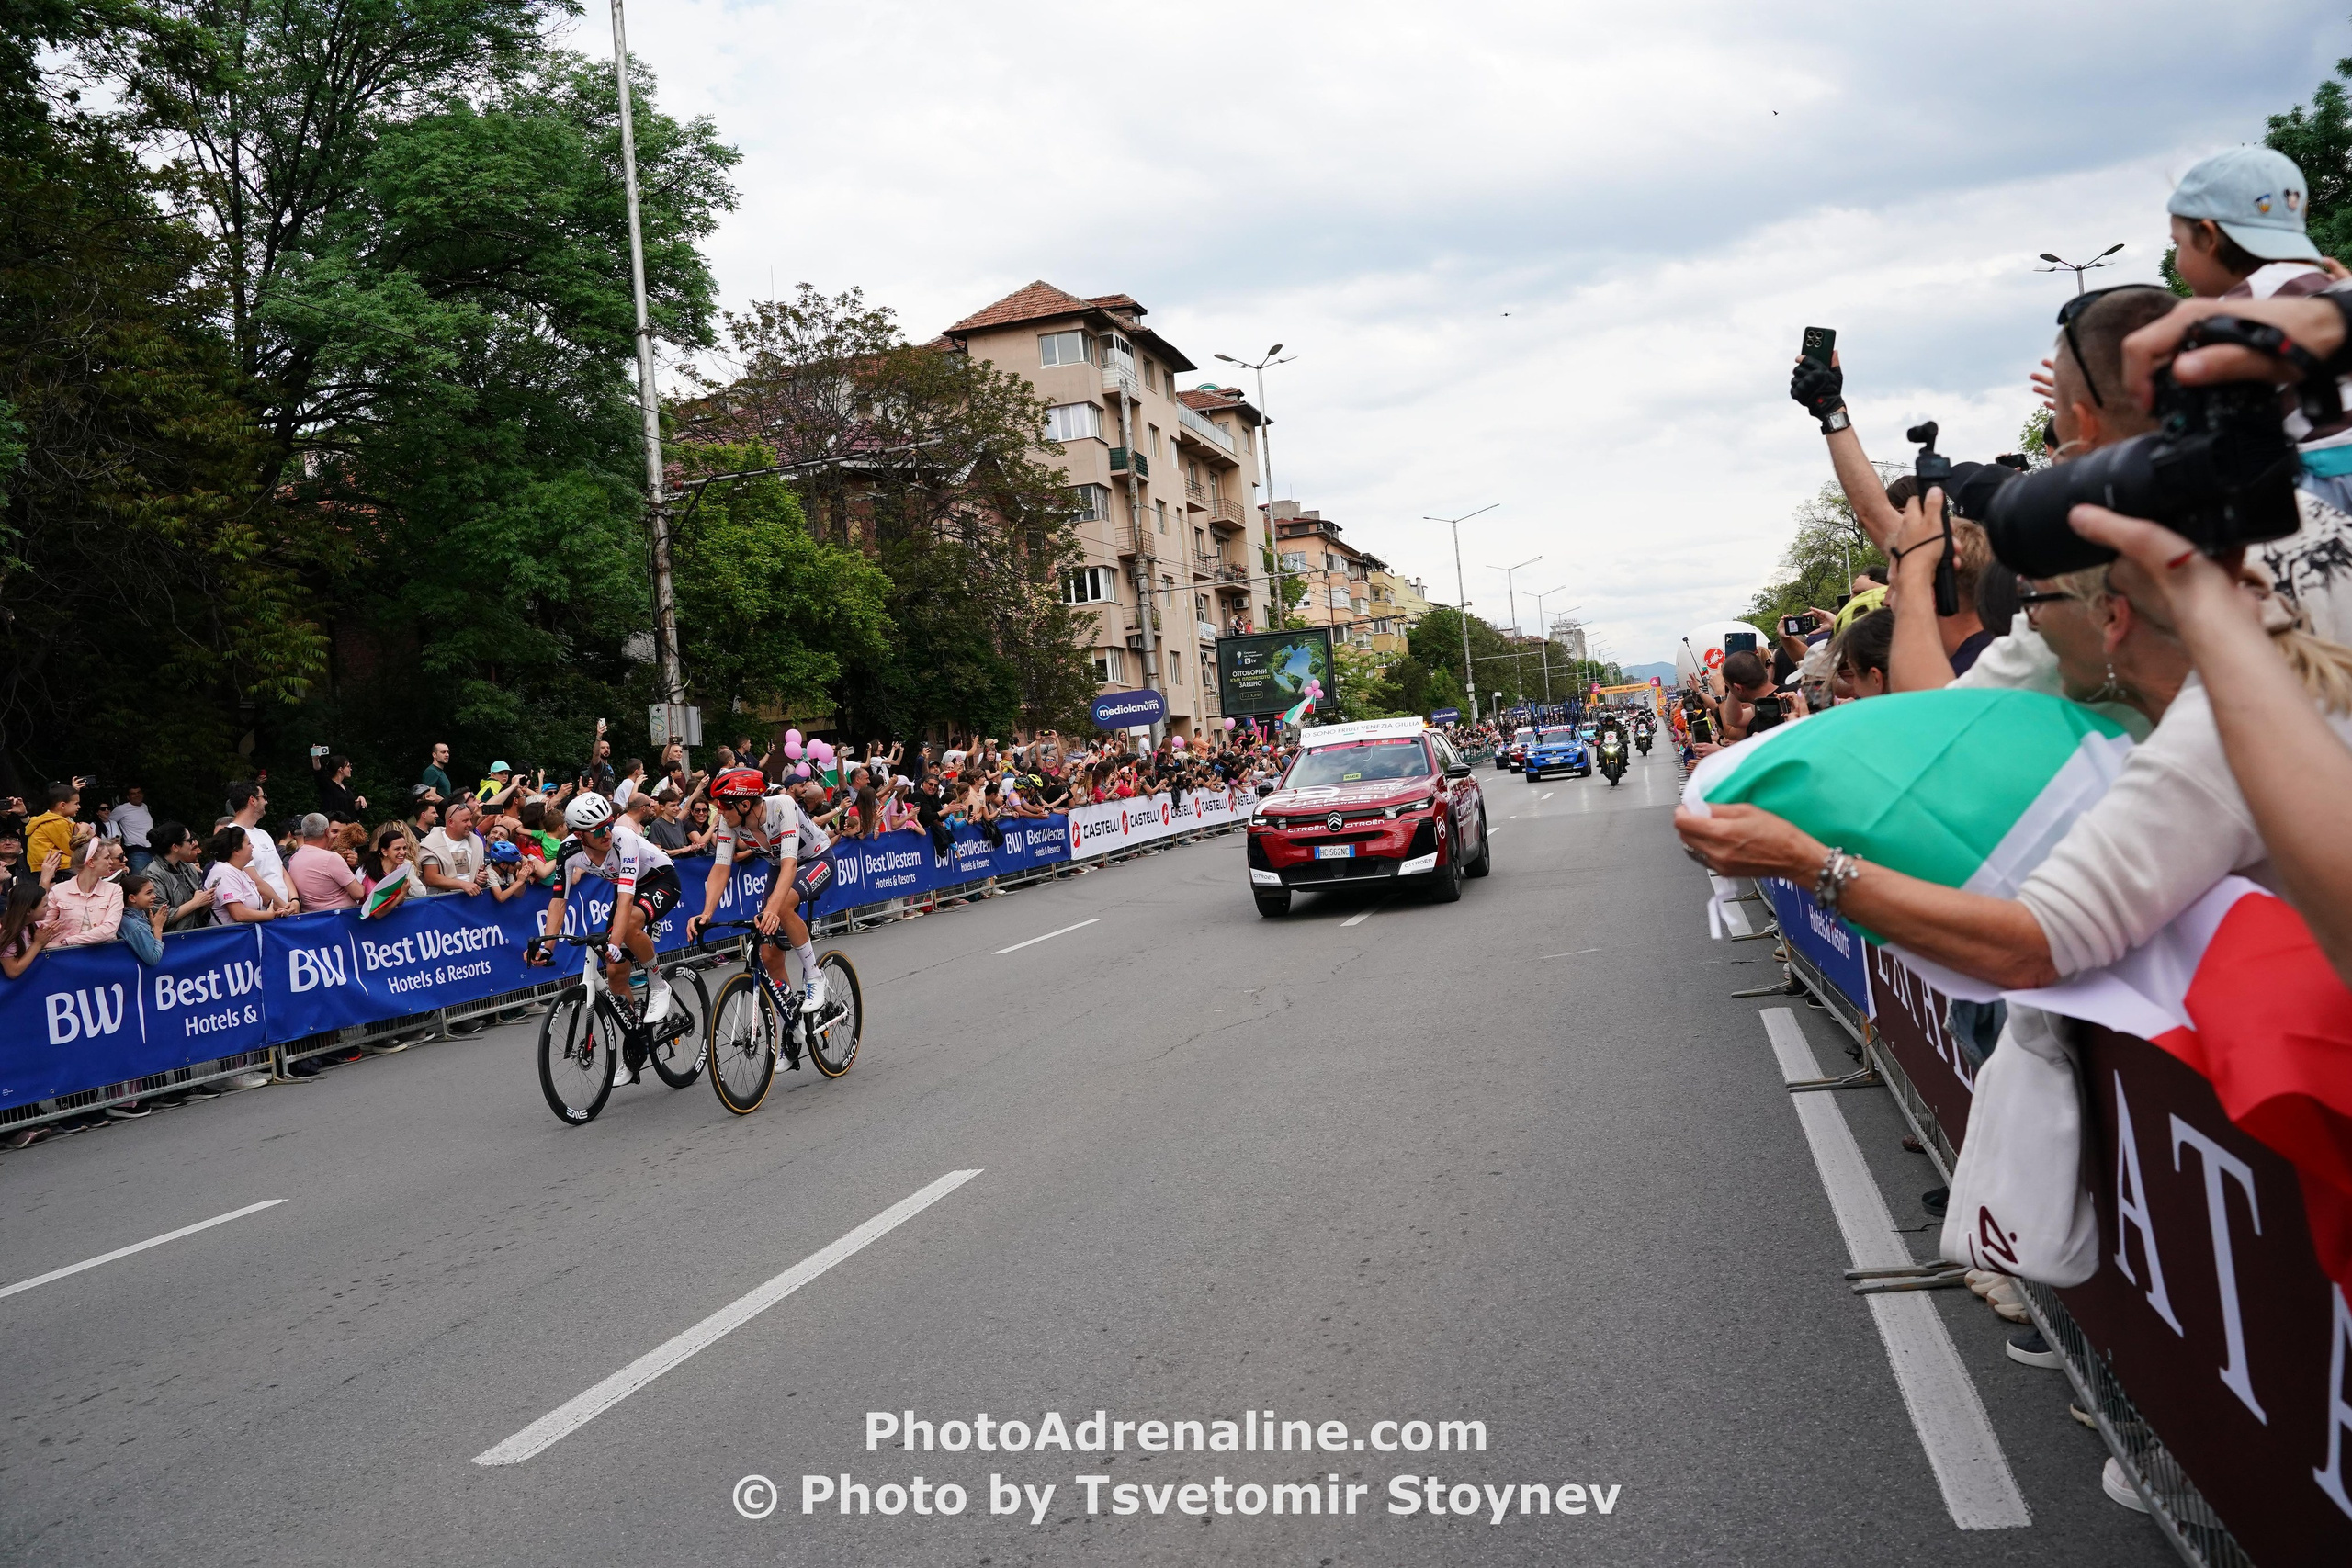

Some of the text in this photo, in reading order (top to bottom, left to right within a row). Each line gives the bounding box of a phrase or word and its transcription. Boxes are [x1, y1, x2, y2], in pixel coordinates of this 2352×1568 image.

[1232, 668, 1267, 677] ОТГОВОРНИ
[1099, 703, 1159, 716] mediolanum
[1312, 728, 1337, 738] SONO
[1338, 726, 1359, 734] FRIULI
[1361, 722, 1393, 731] VENEZIA
[1395, 720, 1420, 728] GIULIA
[1201, 797, 1227, 812] CASTELLI
[1236, 794, 1255, 807] ASTELLI
[1083, 818, 1121, 839] CASTELLI
[1129, 810, 1159, 827] CASTELLI
[1005, 830, 1022, 855] BW
[1026, 829, 1042, 846] Best
[865, 851, 922, 874] Best Western
[1034, 846, 1047, 858] Hotels
[837, 856, 859, 886] BW
[960, 861, 974, 873] Hotels
[976, 858, 989, 869] Resorts
[743, 872, 768, 897] Best
[810, 868, 831, 890] SOUDAL
[875, 874, 916, 889] Hotels & Resorts
[361, 924, 505, 971] Best Western
[289, 943, 347, 993] BW
[388, 959, 492, 994] Hotels & Resorts
[155, 969, 223, 1011] Best
[45, 982, 124, 1045] BW
[185, 1004, 259, 1037] Hotels &
[605, 989, 633, 1031] COLNAGO
